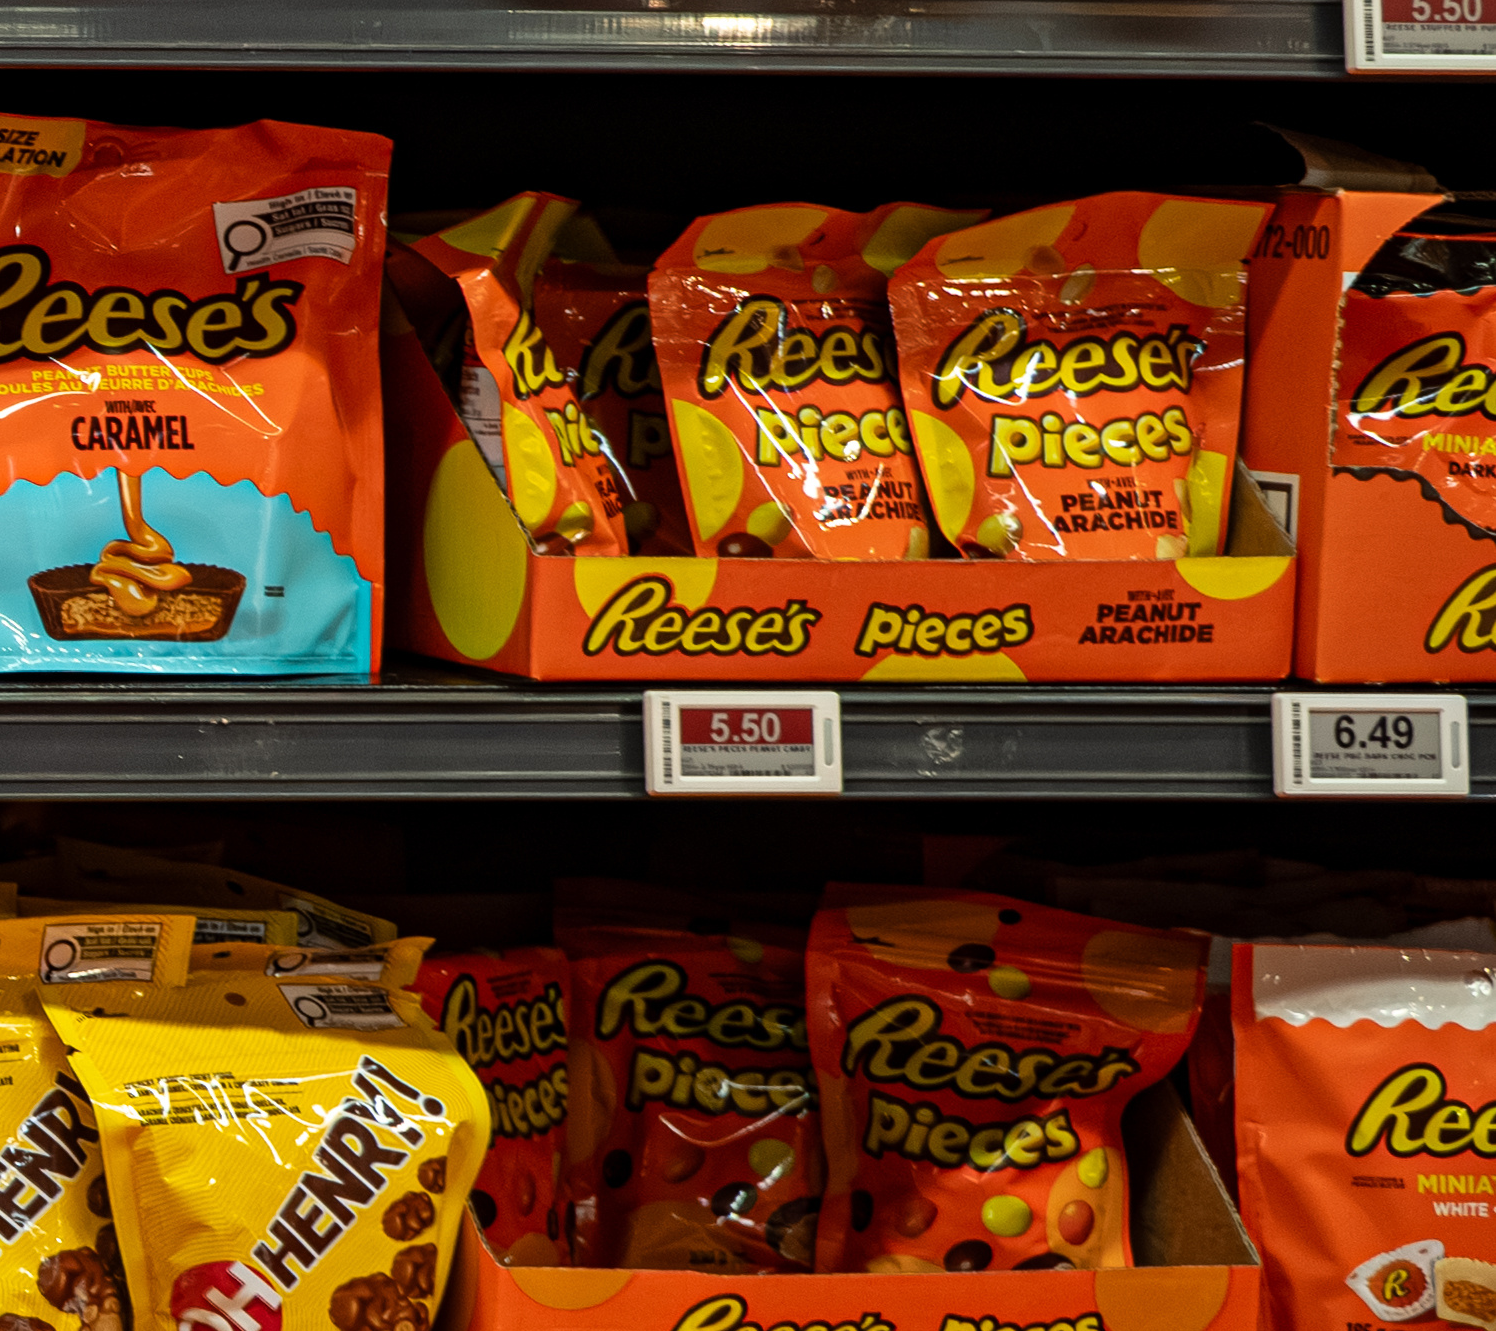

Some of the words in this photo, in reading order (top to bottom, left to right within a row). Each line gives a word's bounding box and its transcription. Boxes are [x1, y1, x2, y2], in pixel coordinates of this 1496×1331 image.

[588, 579, 816, 654] Reese's
[863, 608, 1031, 652] pieces
[1096, 601, 1201, 622] PEANUT
[1080, 622, 1213, 644] ARACHIDE
[709, 712, 781, 742] 5.50
[1334, 716, 1414, 748] 6.49
